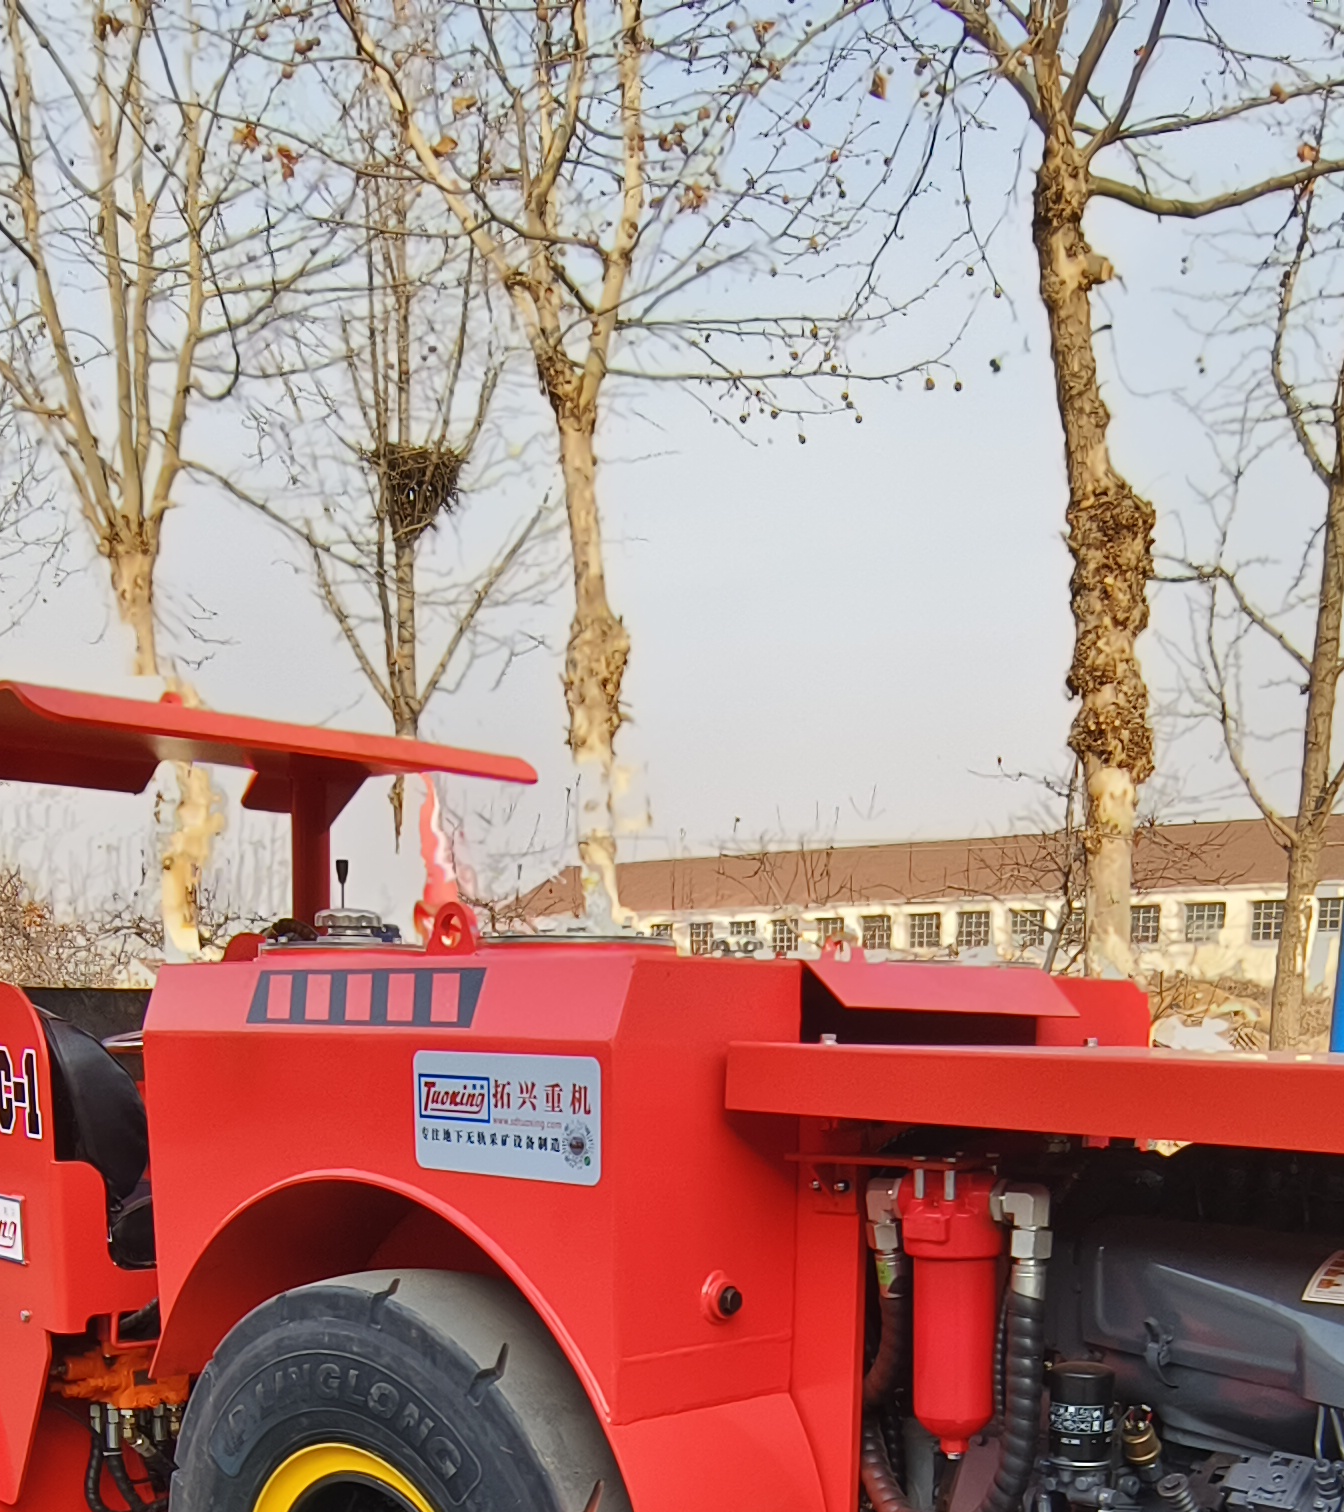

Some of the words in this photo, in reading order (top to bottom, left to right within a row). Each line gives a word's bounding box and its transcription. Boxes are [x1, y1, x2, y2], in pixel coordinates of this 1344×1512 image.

[423, 1081, 485, 1115] Tuoxing
[492, 1079, 592, 1115] 拓兴重机
